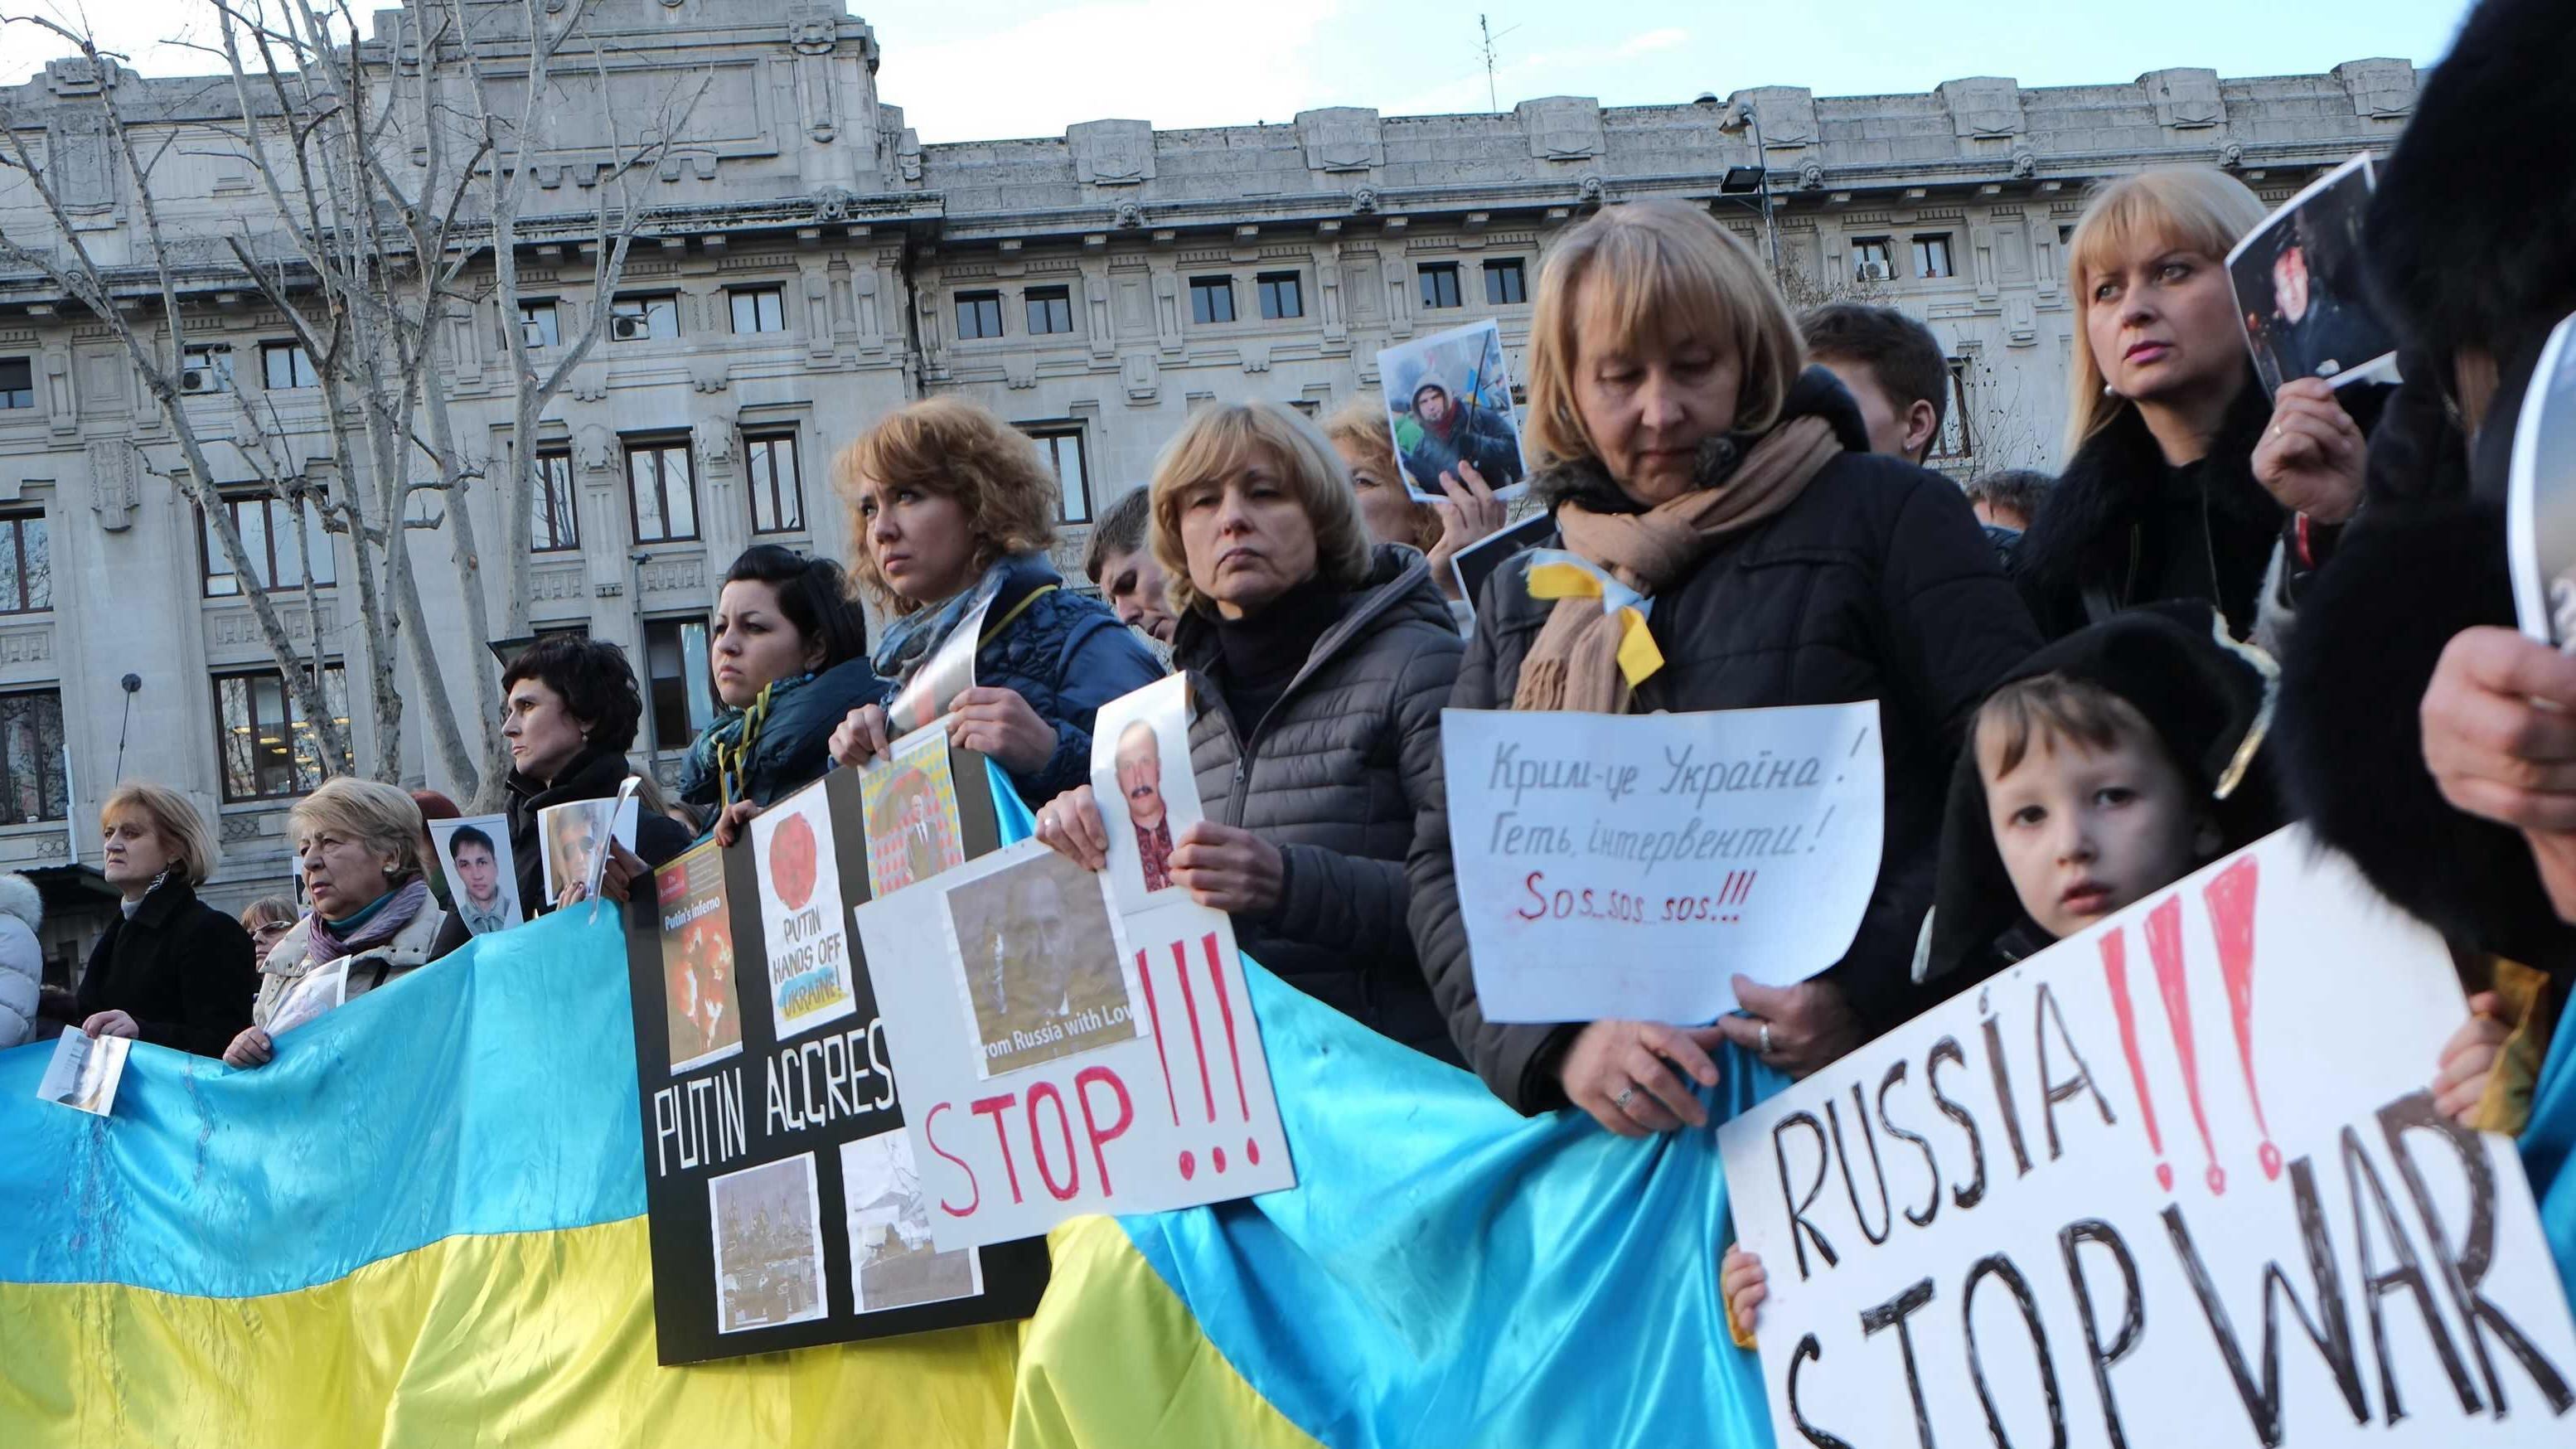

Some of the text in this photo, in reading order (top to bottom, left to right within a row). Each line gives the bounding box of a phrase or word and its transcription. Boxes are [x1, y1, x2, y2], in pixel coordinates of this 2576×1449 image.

[665, 896, 720, 931] Putin's inferno
[772, 933, 841, 985] HANDS OFF
[983, 1004, 1135, 1059] rom Russia with Lov
[653, 1017, 895, 1177] PUTIN AGGRES
[1786, 1086, 2575, 1449] STOP WAR
